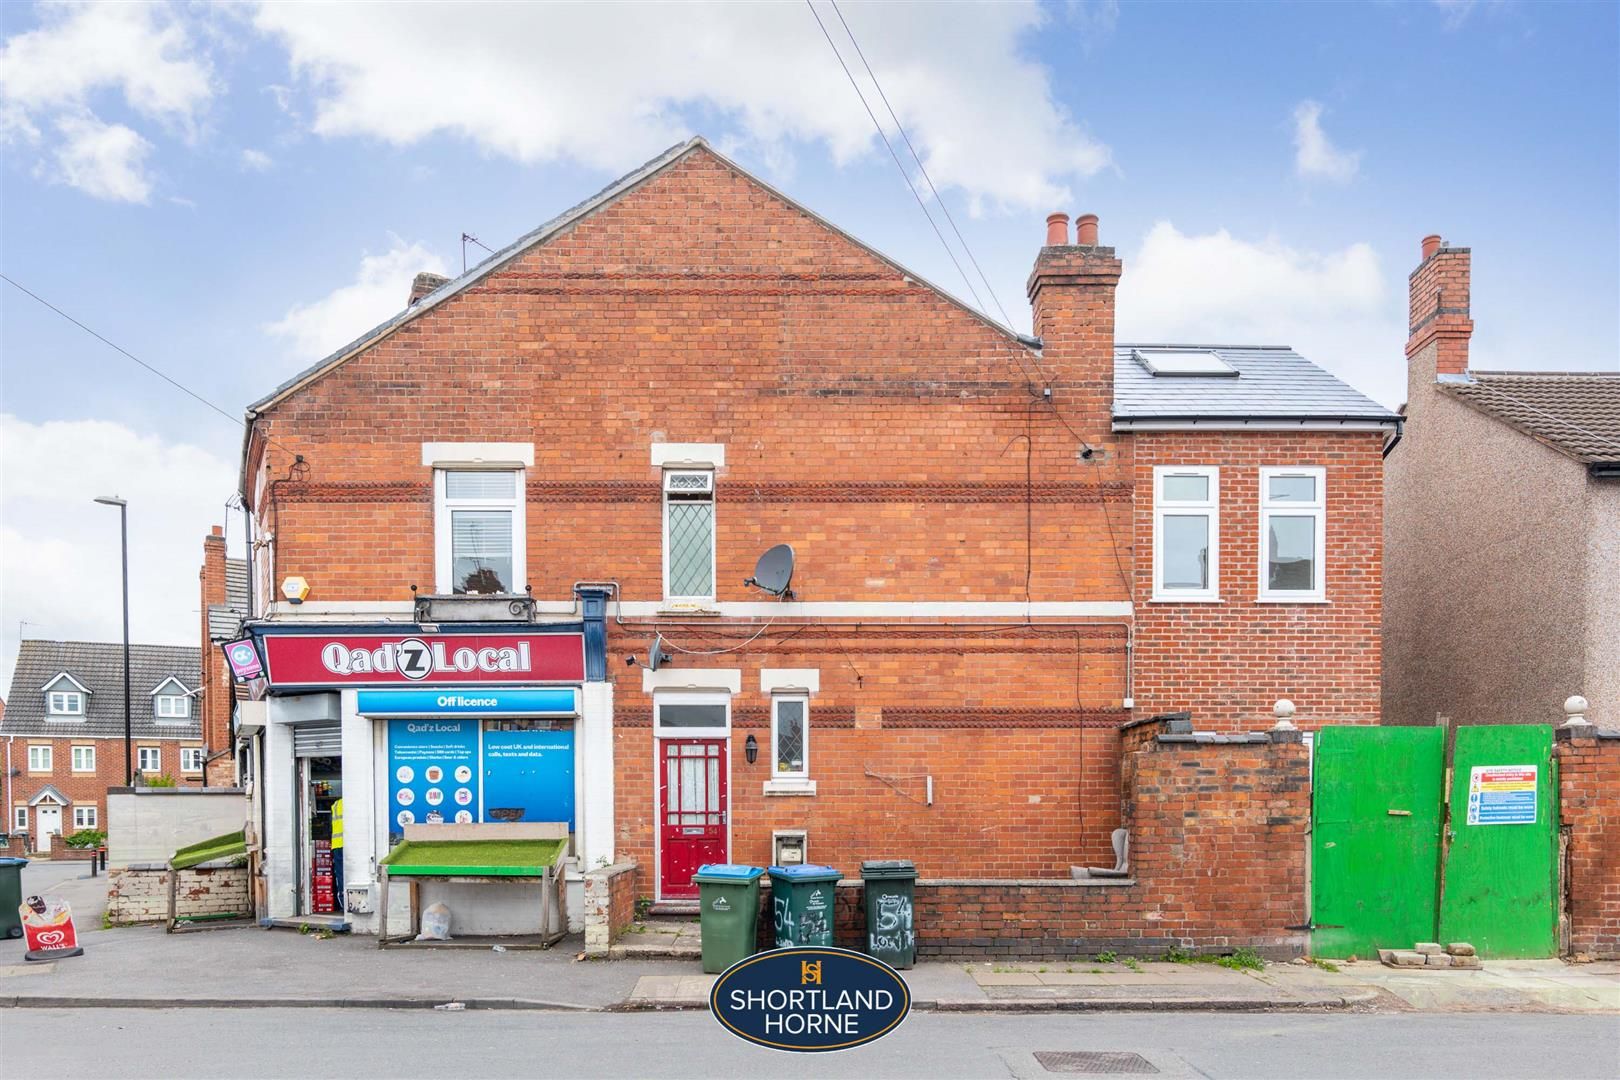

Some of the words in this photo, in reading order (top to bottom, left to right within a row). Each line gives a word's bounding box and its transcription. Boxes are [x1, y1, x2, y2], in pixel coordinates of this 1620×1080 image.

[431, 641, 531, 672] Local
[437, 696, 457, 707] Off
[457, 696, 498, 707] licence
[407, 723, 434, 733] Qad'z
[435, 723, 461, 732] Local
[774, 896, 795, 938] 54
[875, 896, 913, 931] 54
